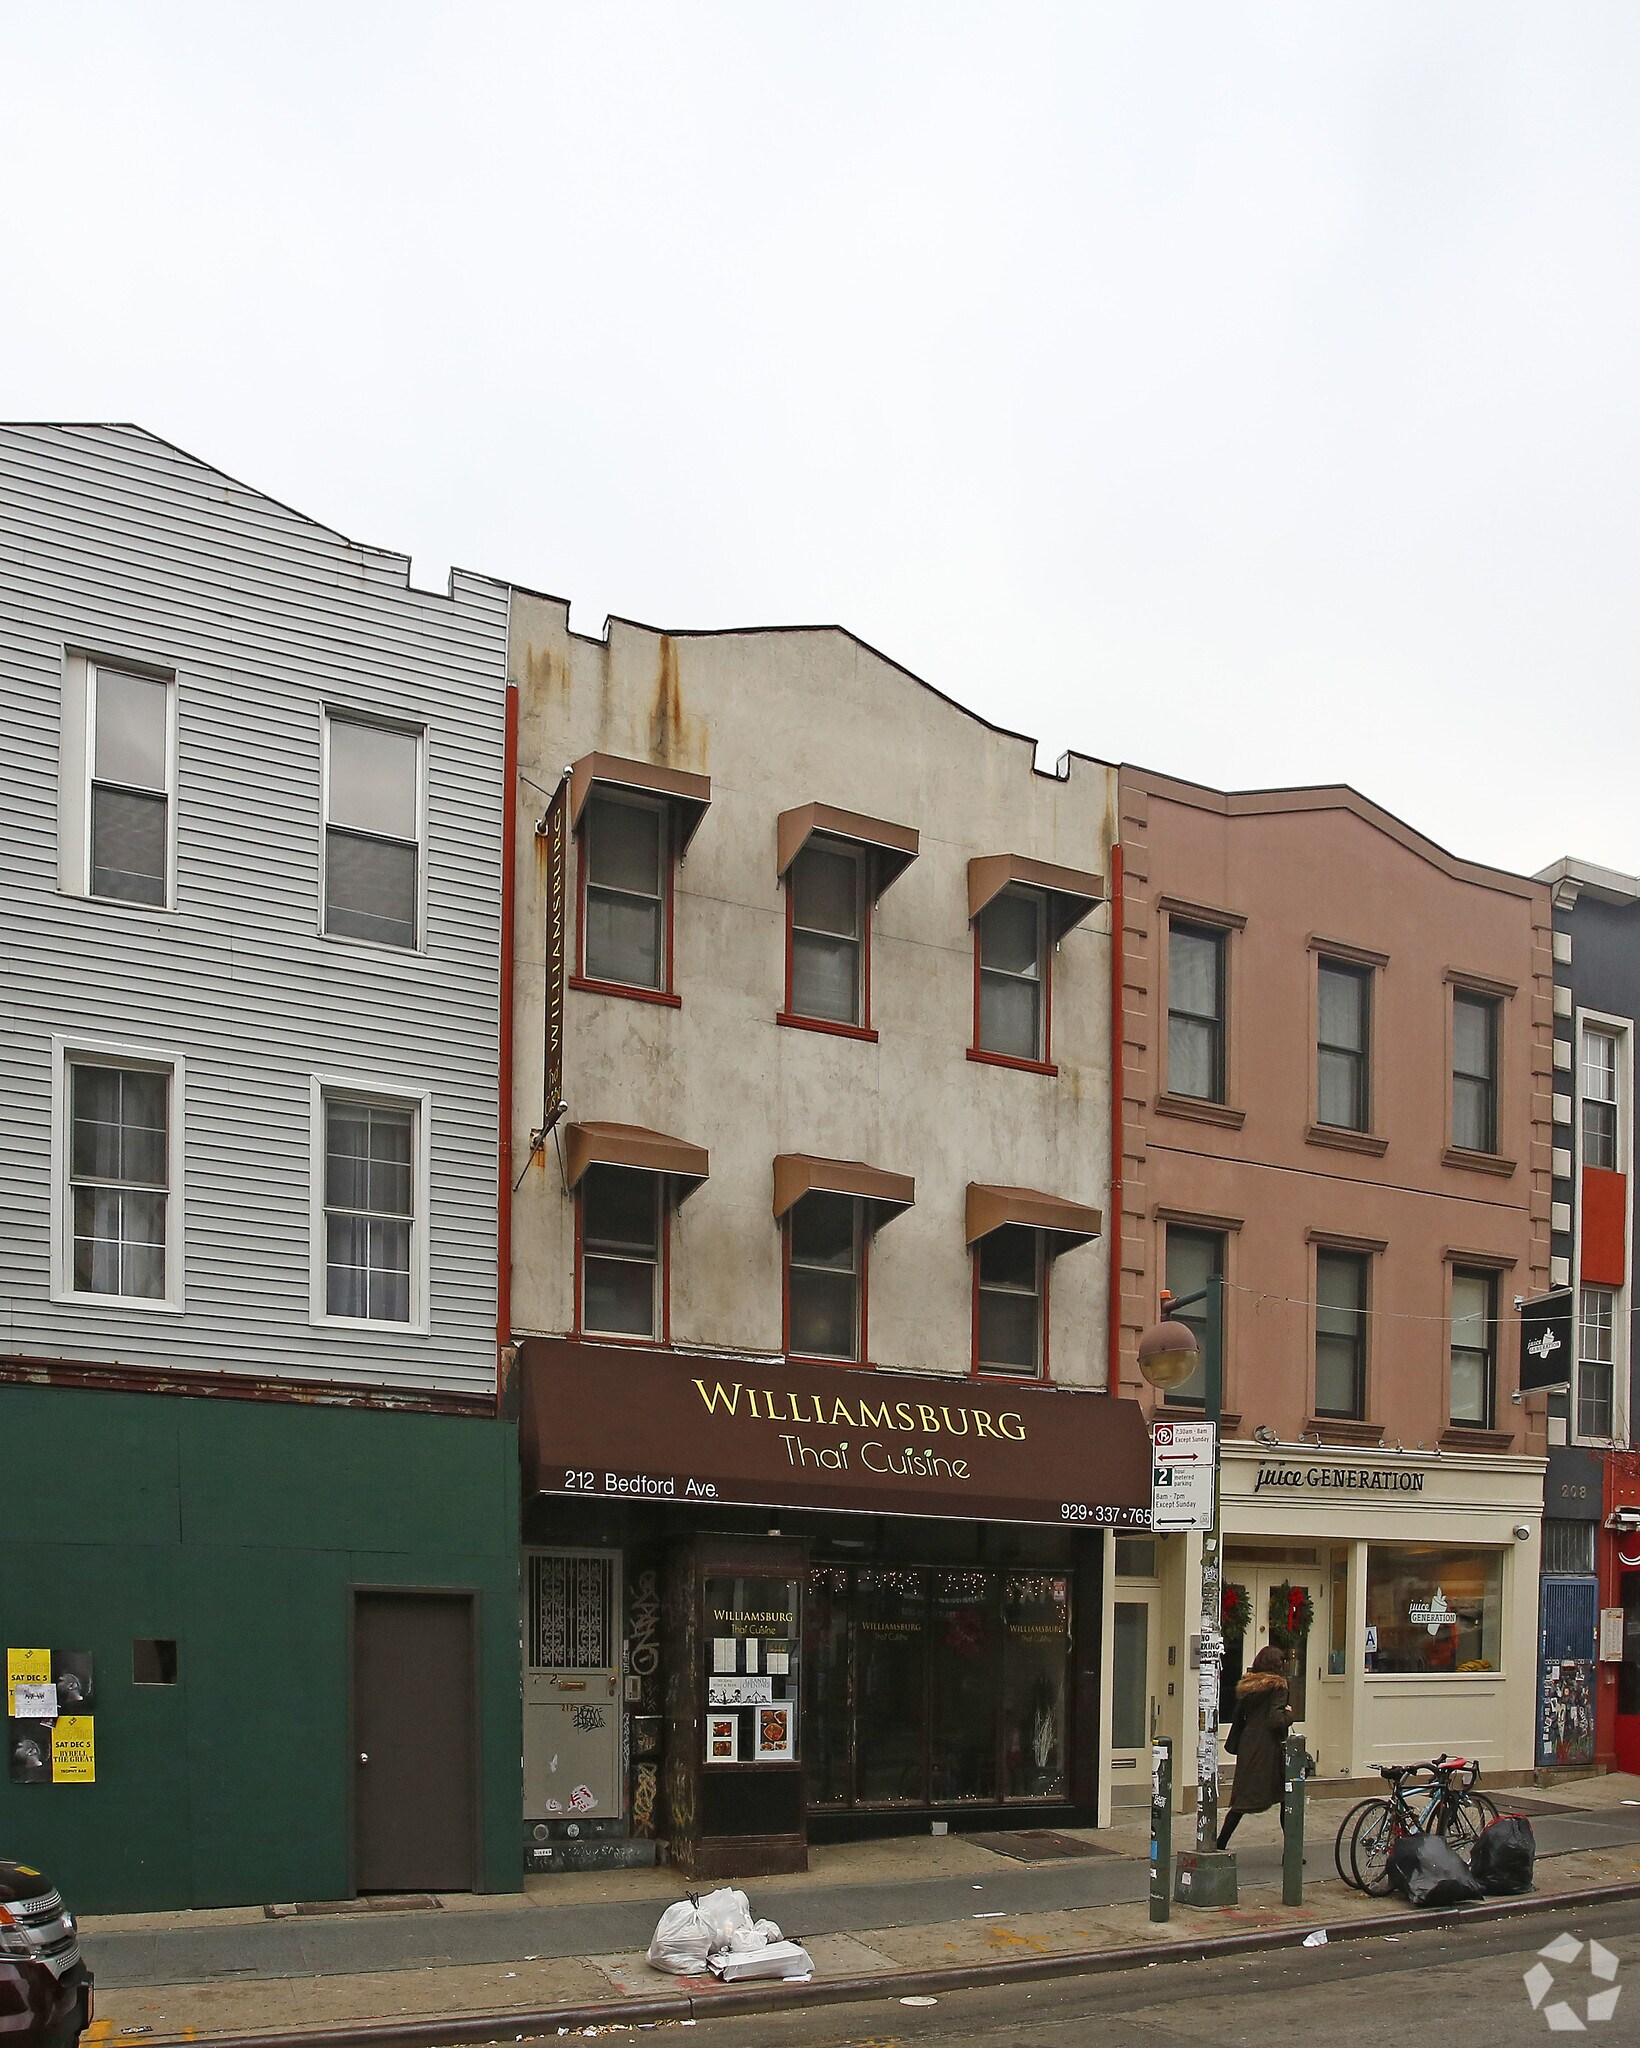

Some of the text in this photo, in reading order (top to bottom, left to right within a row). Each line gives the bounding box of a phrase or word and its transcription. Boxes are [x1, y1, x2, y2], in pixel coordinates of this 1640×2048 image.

[691, 1378, 1027, 1441] WILLIAMSBURG
[1175, 1435, 1210, 1444] Except Sunday
[778, 1433, 971, 1480] Thai Cuisine
[564, 1469, 719, 1498] 212 Bedford Ave.
[1158, 1468, 1168, 1485] 2
[1254, 1461, 1425, 1493] juice GENERATION
[1561, 1484, 1587, 1499] 208
[1156, 1500, 1197, 1509] Except Sunday
[1408, 1599, 1430, 1615] juice
[713, 1609, 793, 1622] WILLIAMSBURG
[1412, 1613, 1456, 1622] GENERATION
[862, 1621, 921, 1631] WILLIAMSBURG
[1365, 1630, 1376, 1646] A
[11, 1674, 48, 1682] SAT DEC 5
[69, 1755, 94, 1763] GREAT
